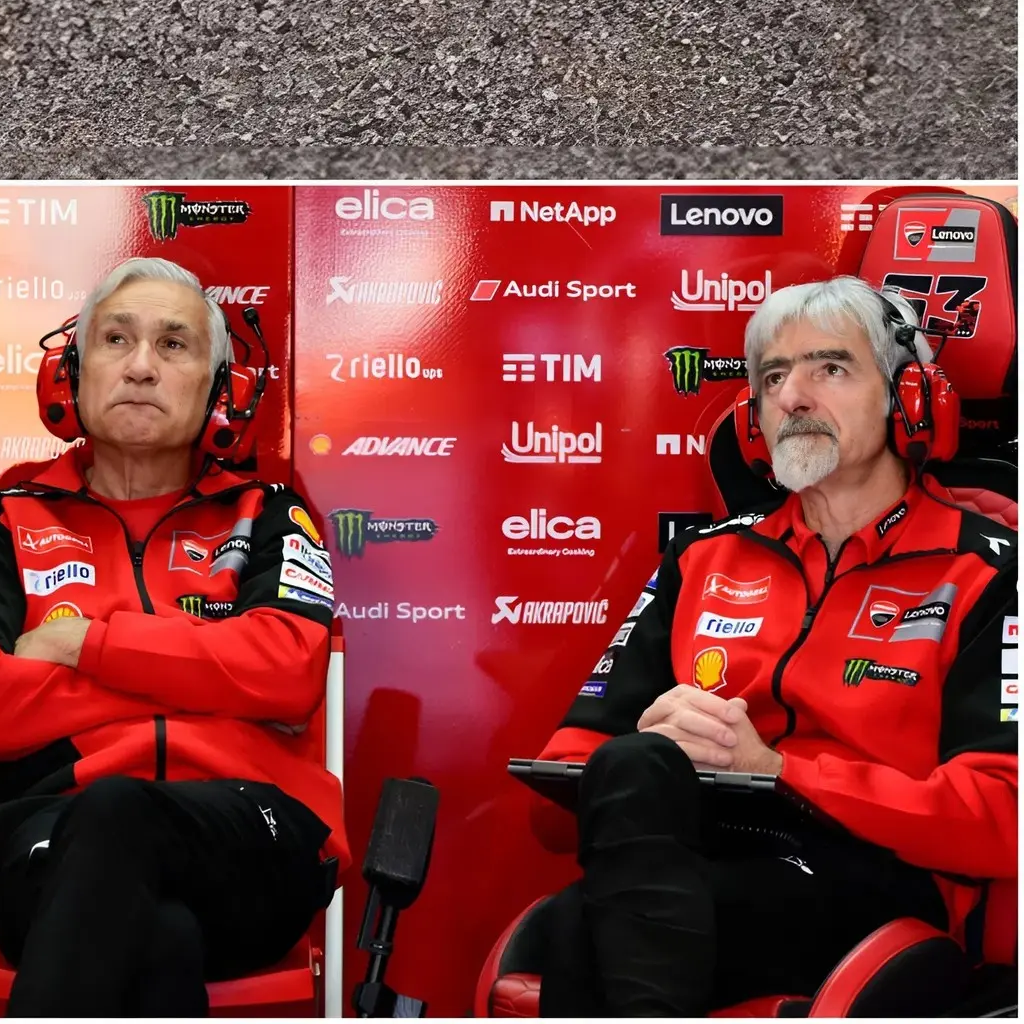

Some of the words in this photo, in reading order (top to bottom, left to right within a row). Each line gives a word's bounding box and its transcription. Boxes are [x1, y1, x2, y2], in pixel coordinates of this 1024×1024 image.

[17, 197, 77, 225] TIM
[334, 188, 435, 221] elica
[520, 201, 617, 226] NetApp
[670, 203, 773, 226] Lenovo
[931, 227, 974, 241] Lenovo
[503, 280, 559, 298] Audi
[566, 280, 637, 301] Sport
[681, 269, 772, 312] Unipol
[349, 353, 421, 378] riello
[540, 354, 602, 382] TIM
[341, 436, 458, 456] ADVANCE
[511, 421, 602, 463] Unipol
[367, 520, 432, 532] MONSTER
[501, 508, 601, 539] elica
[45, 564, 90, 589] riello
[333, 602, 389, 619] Audi
[396, 602, 466, 623] Sport
[706, 619, 756, 635] riello
